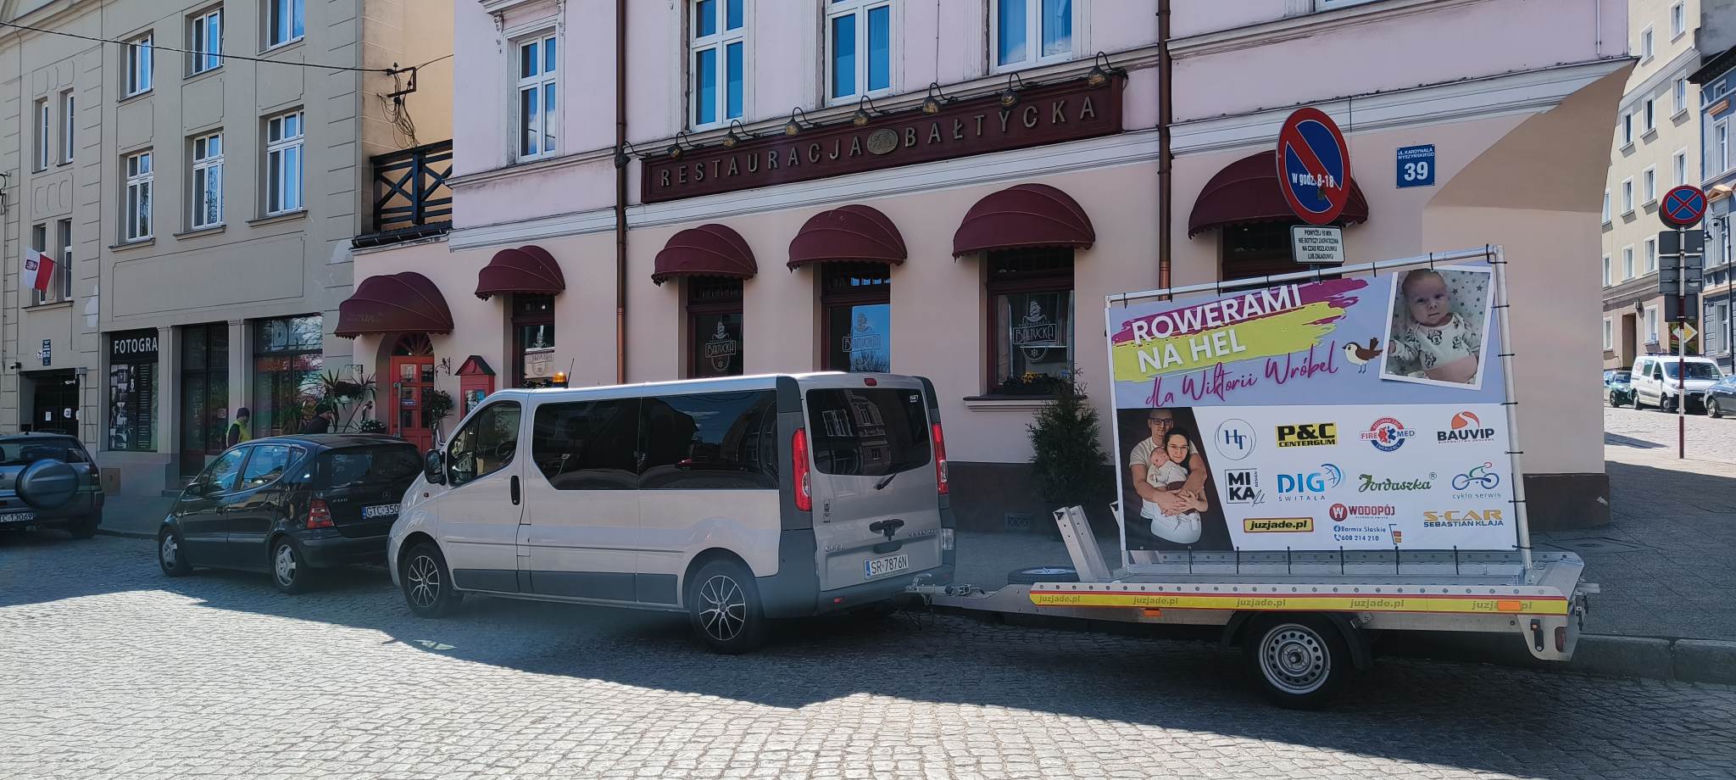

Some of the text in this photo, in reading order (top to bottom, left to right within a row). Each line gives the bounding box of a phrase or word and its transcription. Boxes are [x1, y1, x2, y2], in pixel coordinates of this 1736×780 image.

[661, 96, 1095, 186] RESTAURACJA BAŁTYCKA
[1404, 161, 1428, 181] 39
[1317, 173, 1334, 188] 8-18
[1132, 283, 1302, 346] ROWERAMI
[114, 336, 158, 354] FOTOGRA
[1137, 328, 1247, 373] NA HEL
[1145, 340, 1339, 408] dla Wiktorii Wróbel
[1277, 422, 1336, 441] P&C
[1360, 430, 1415, 440] FIRE MED
[1437, 428, 1495, 442] BAUVIP
[1278, 438, 1336, 448] CENTERGUM
[1227, 471, 1251, 486] MI
[1276, 473, 1325, 494] DIG
[1229, 486, 1256, 501] KA
[384, 504, 400, 515] 350
[1348, 504, 1396, 517] WODOPÓJ
[1250, 520, 1308, 531] juzjade.pl
[1423, 519, 1504, 528] SEBASTIAN KLAJA
[871, 555, 907, 574] SR 7876N
[1039, 595, 1080, 603] juzjade.pl
[1134, 597, 1178, 605] juzjade.pl
[1237, 599, 1286, 607] juzjade.pl
[1350, 599, 1404, 608] juzjade.pl
